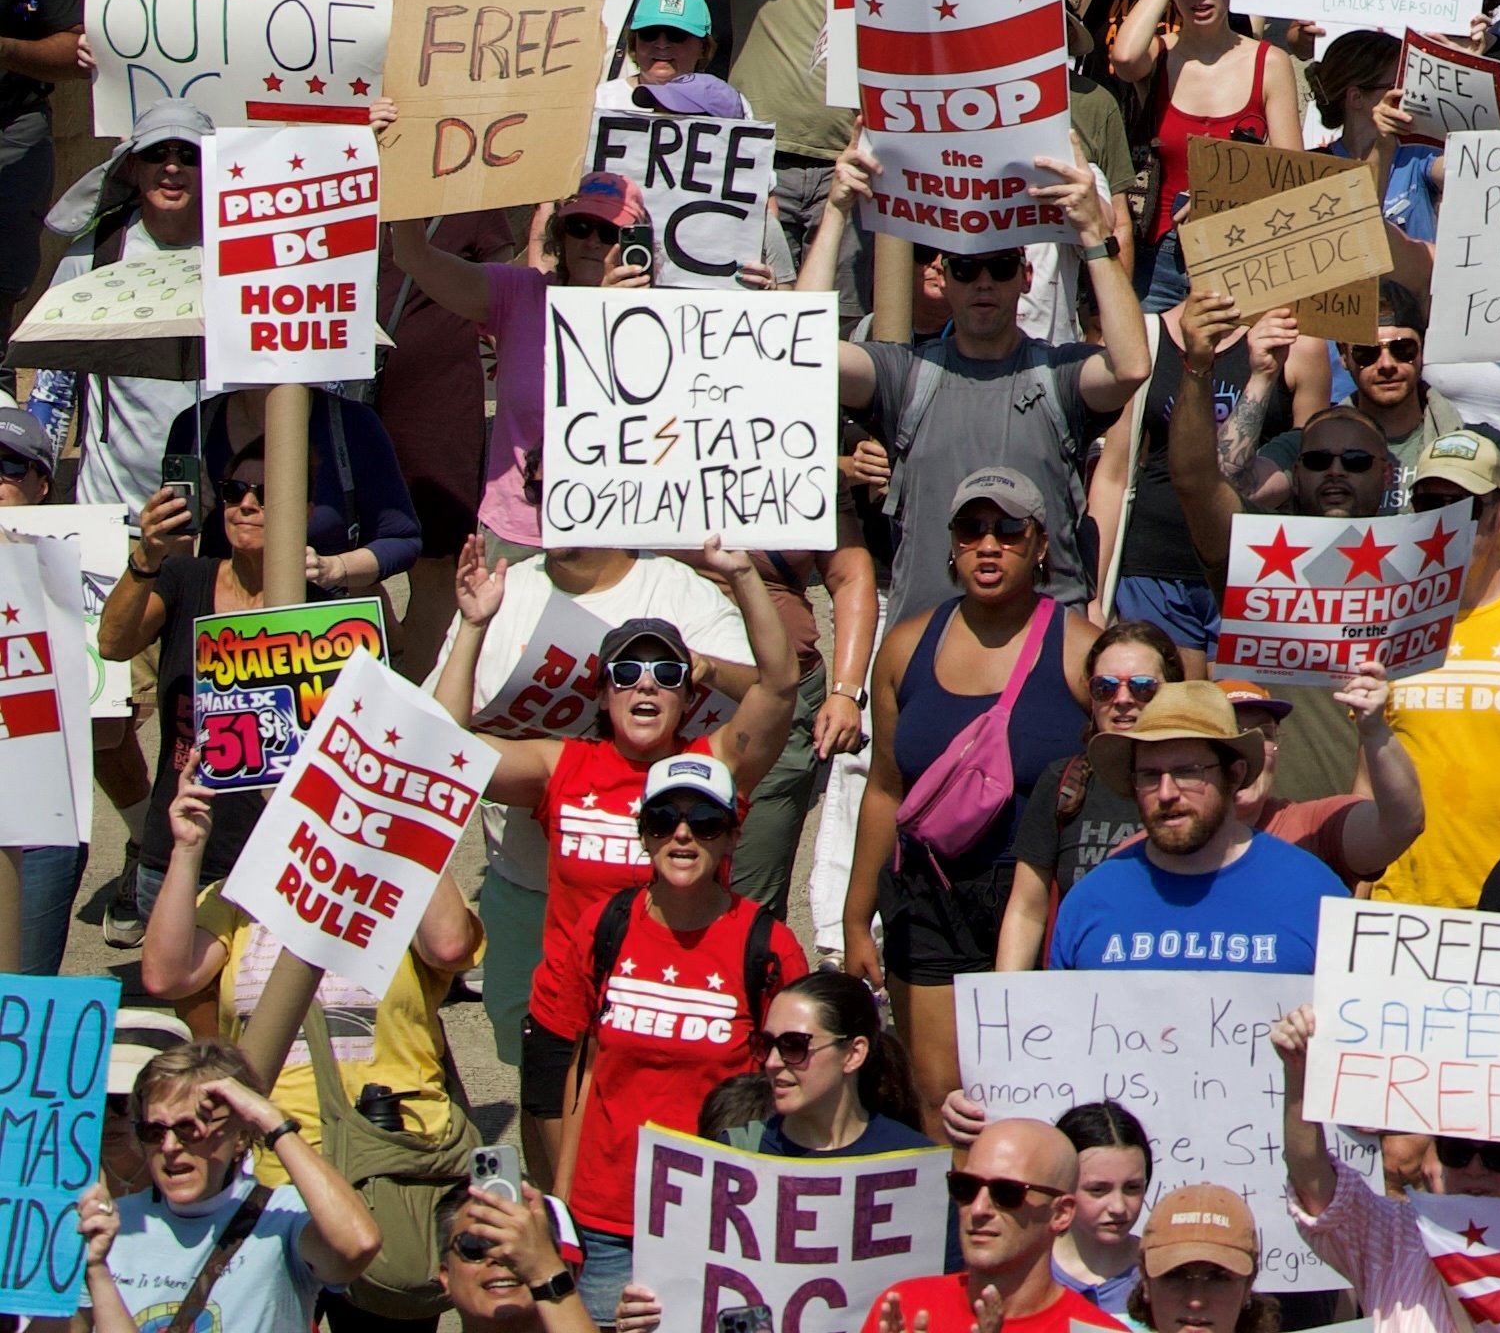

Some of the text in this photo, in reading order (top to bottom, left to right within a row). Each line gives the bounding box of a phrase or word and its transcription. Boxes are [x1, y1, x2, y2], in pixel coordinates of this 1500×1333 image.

[552, 303, 824, 407] NO PEACE
[565, 414, 817, 466] GESTAPO
[547, 465, 826, 530] COSPLAY FREAKS
[1101, 931, 1278, 965] ABOLISH
